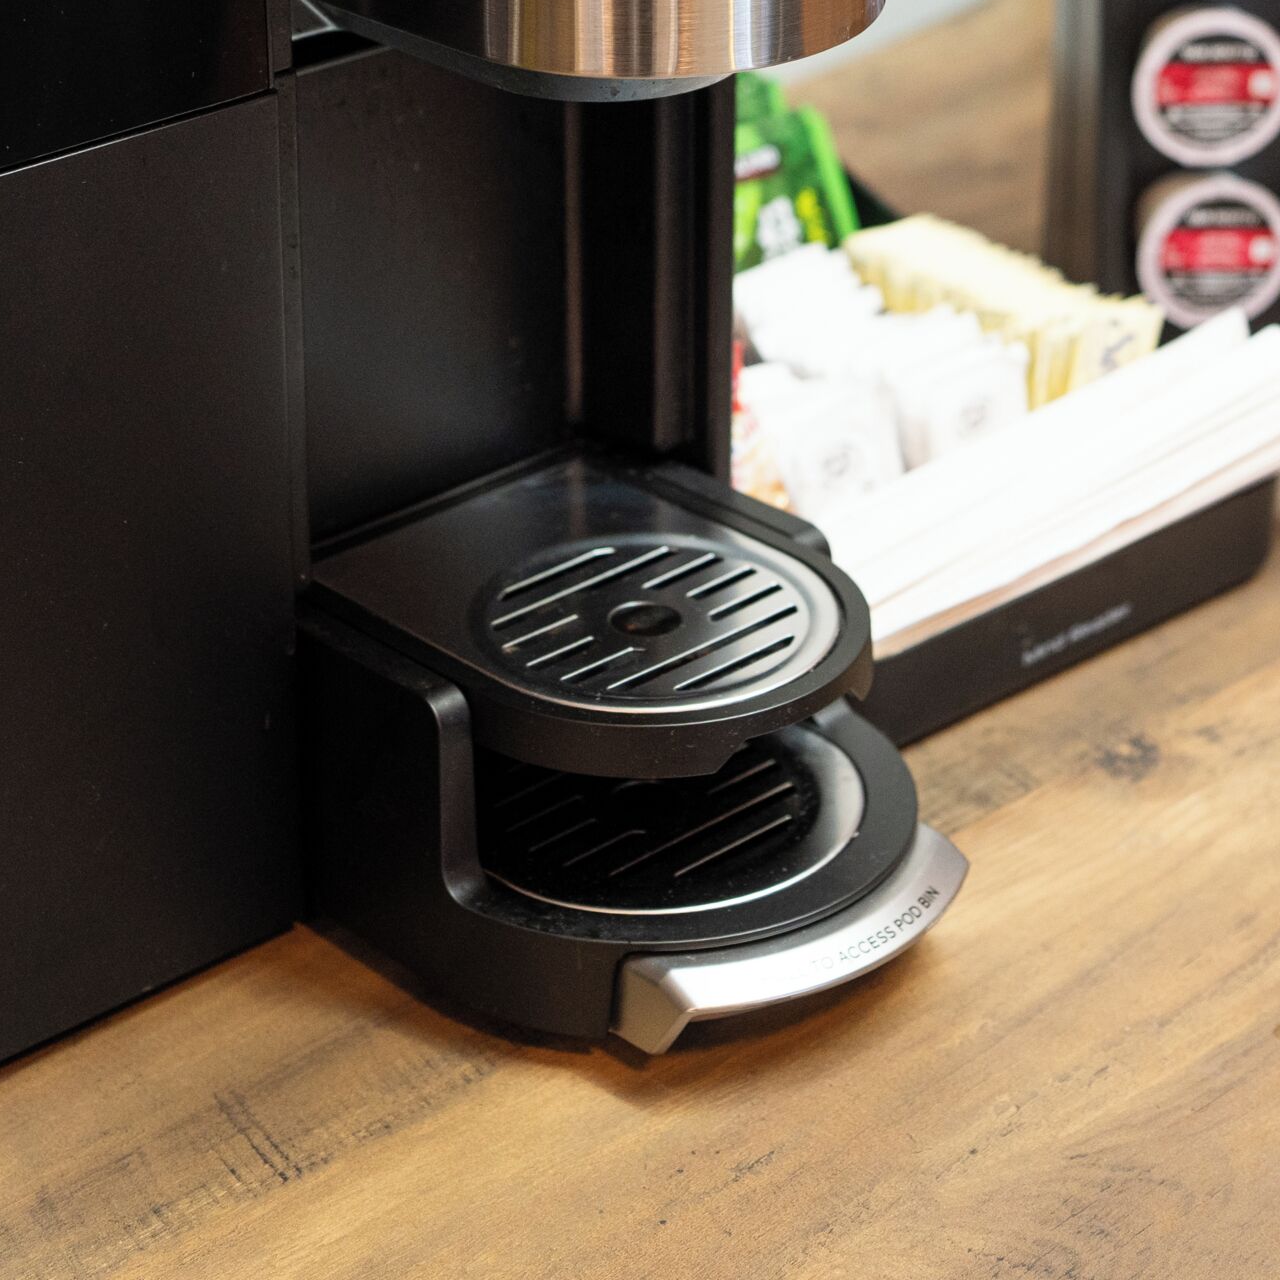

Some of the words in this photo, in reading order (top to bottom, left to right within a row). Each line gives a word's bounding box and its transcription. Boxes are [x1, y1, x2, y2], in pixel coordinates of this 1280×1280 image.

[838, 925, 897, 963] ACCESS
[892, 904, 923, 933] POD
[917, 885, 940, 910] BIN
